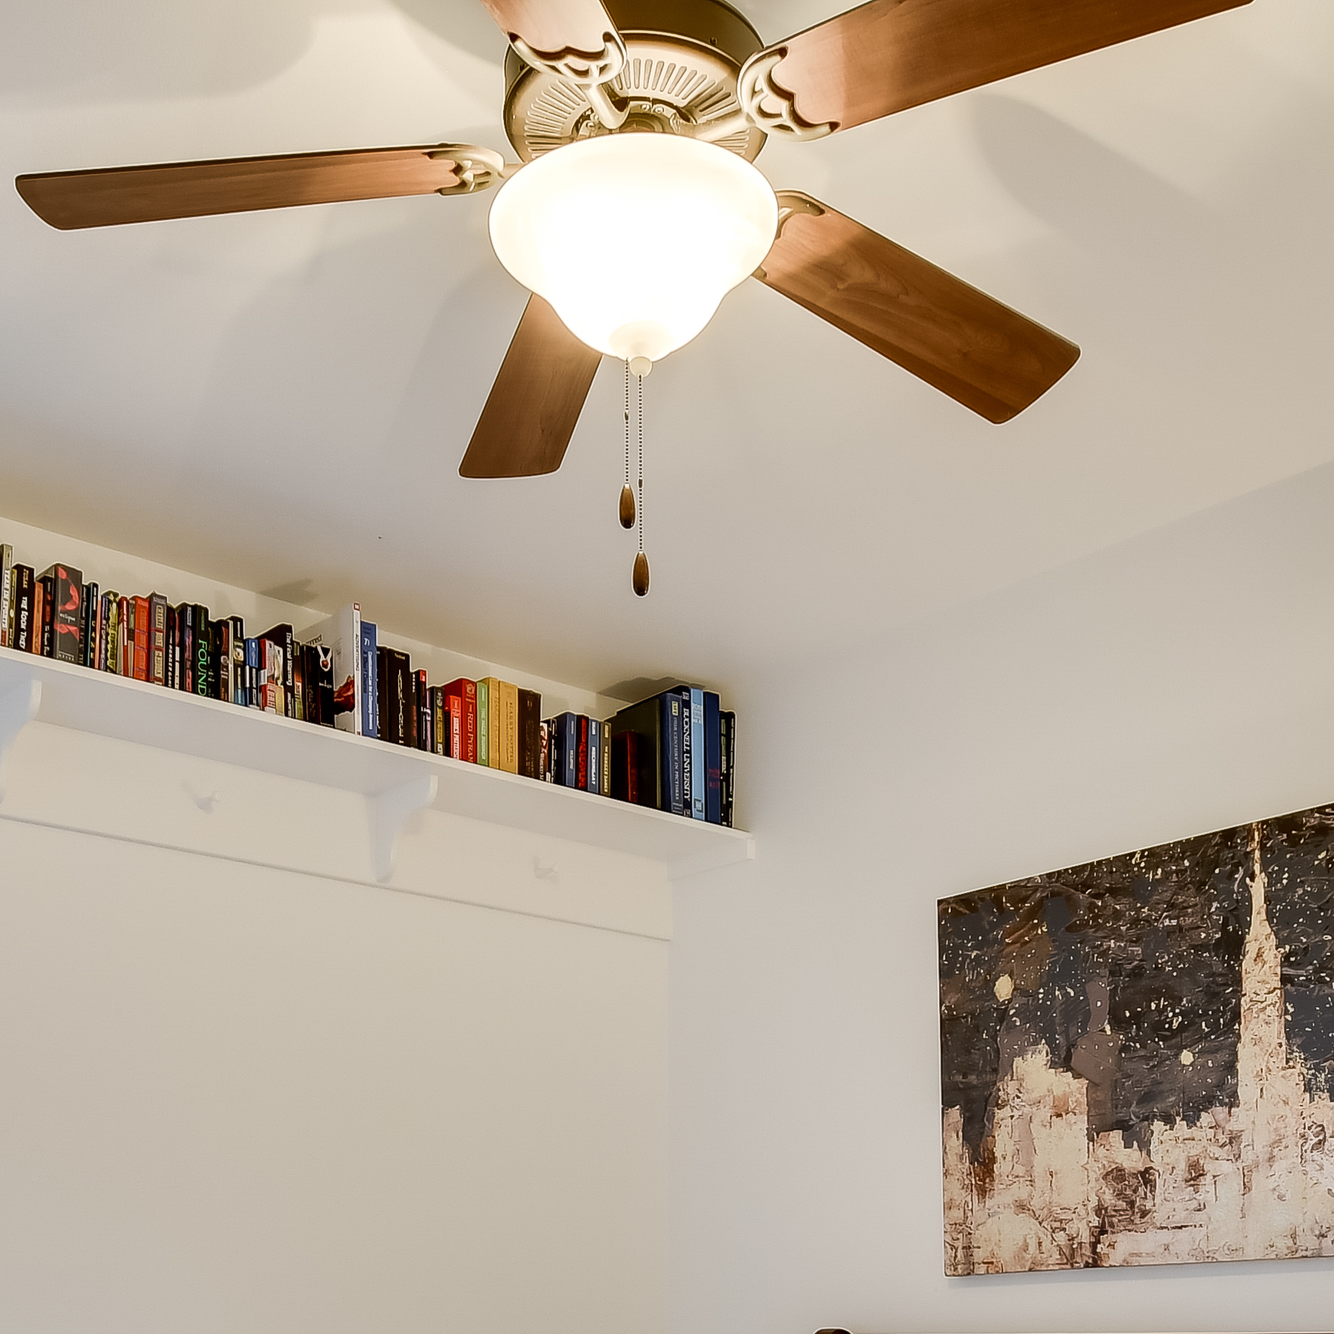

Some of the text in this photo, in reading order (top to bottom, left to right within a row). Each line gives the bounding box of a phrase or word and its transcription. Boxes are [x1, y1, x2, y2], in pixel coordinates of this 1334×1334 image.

[20, 596, 28, 610] THE
[198, 638, 208, 697] FOUND
[682, 707, 691, 802] BUCKNELL UNIVERSITY
